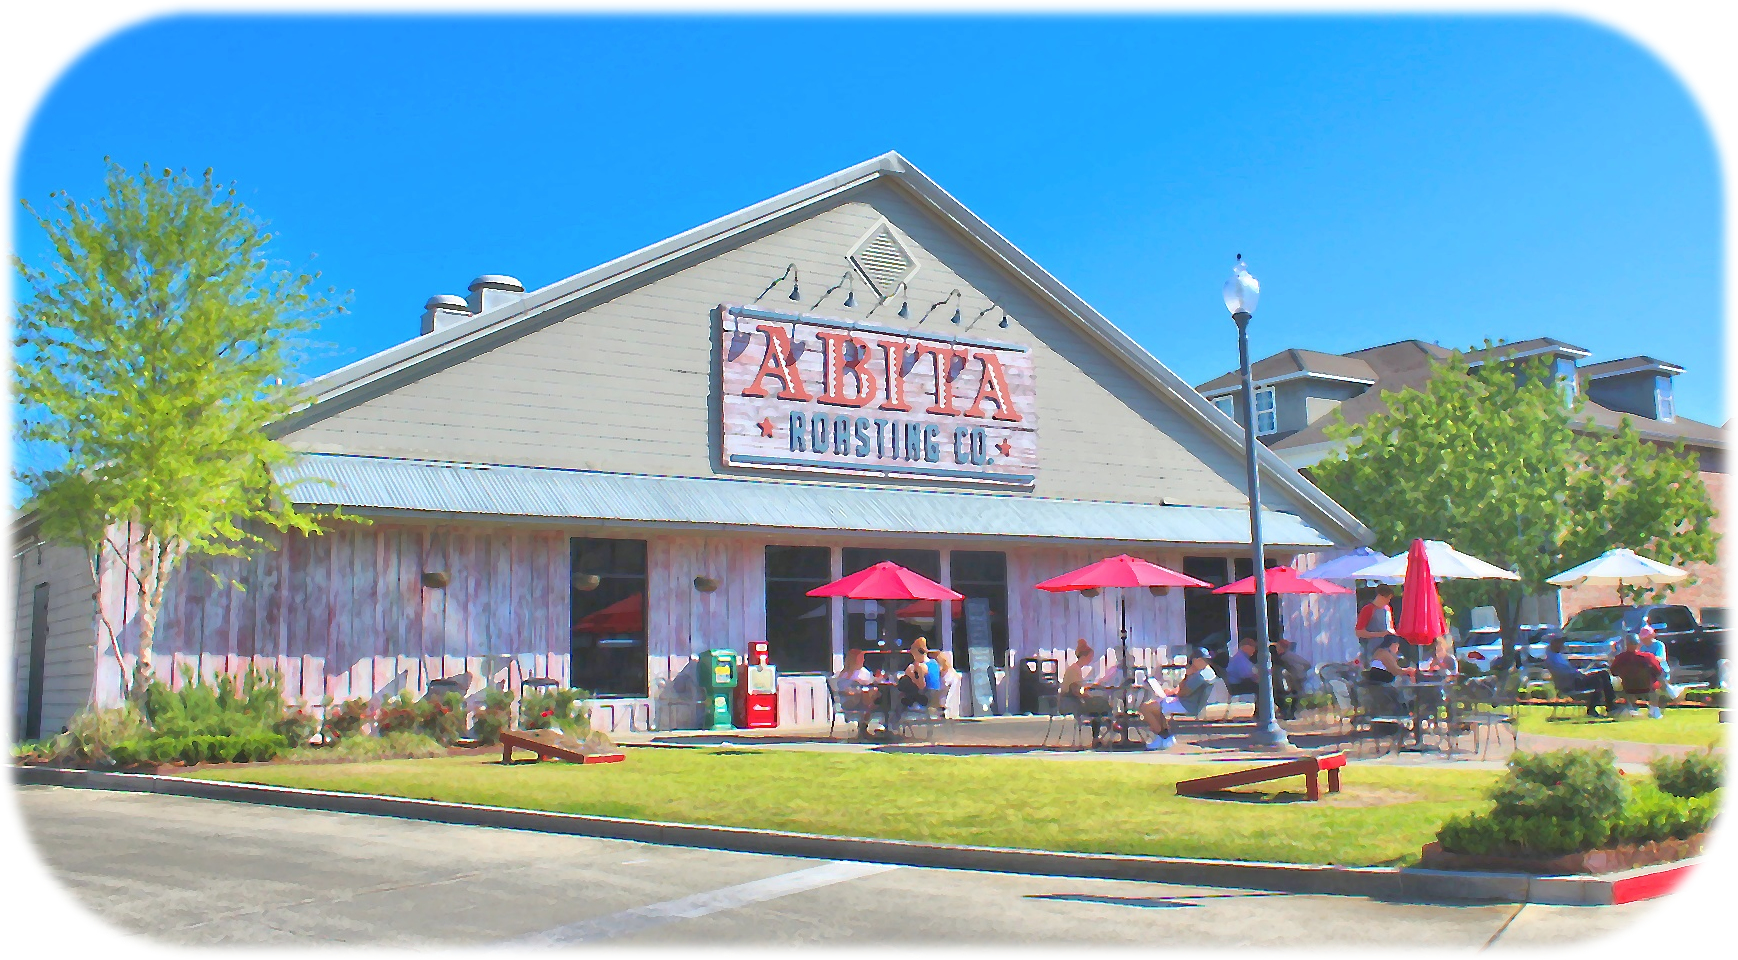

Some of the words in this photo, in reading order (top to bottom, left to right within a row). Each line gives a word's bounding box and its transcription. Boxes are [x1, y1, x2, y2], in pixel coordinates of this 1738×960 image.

[741, 324, 1023, 422] ABITA
[789, 410, 940, 463] ROASTING
[954, 426, 995, 466] CO.
